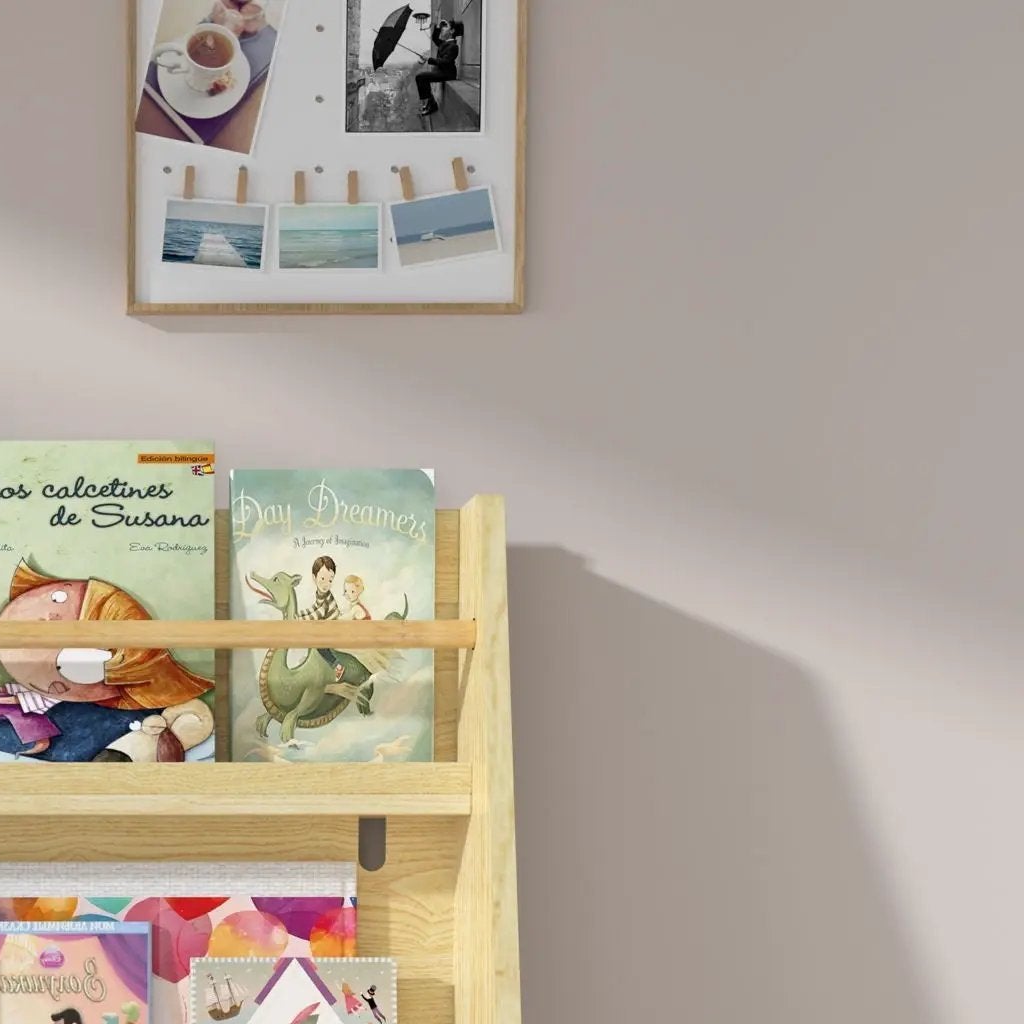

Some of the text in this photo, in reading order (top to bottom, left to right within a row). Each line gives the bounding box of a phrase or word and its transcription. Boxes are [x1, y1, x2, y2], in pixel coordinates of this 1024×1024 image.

[41, 475, 173, 500] calcetines
[49, 502, 210, 528] de Susana
[233, 477, 427, 543] Day Dreamers
